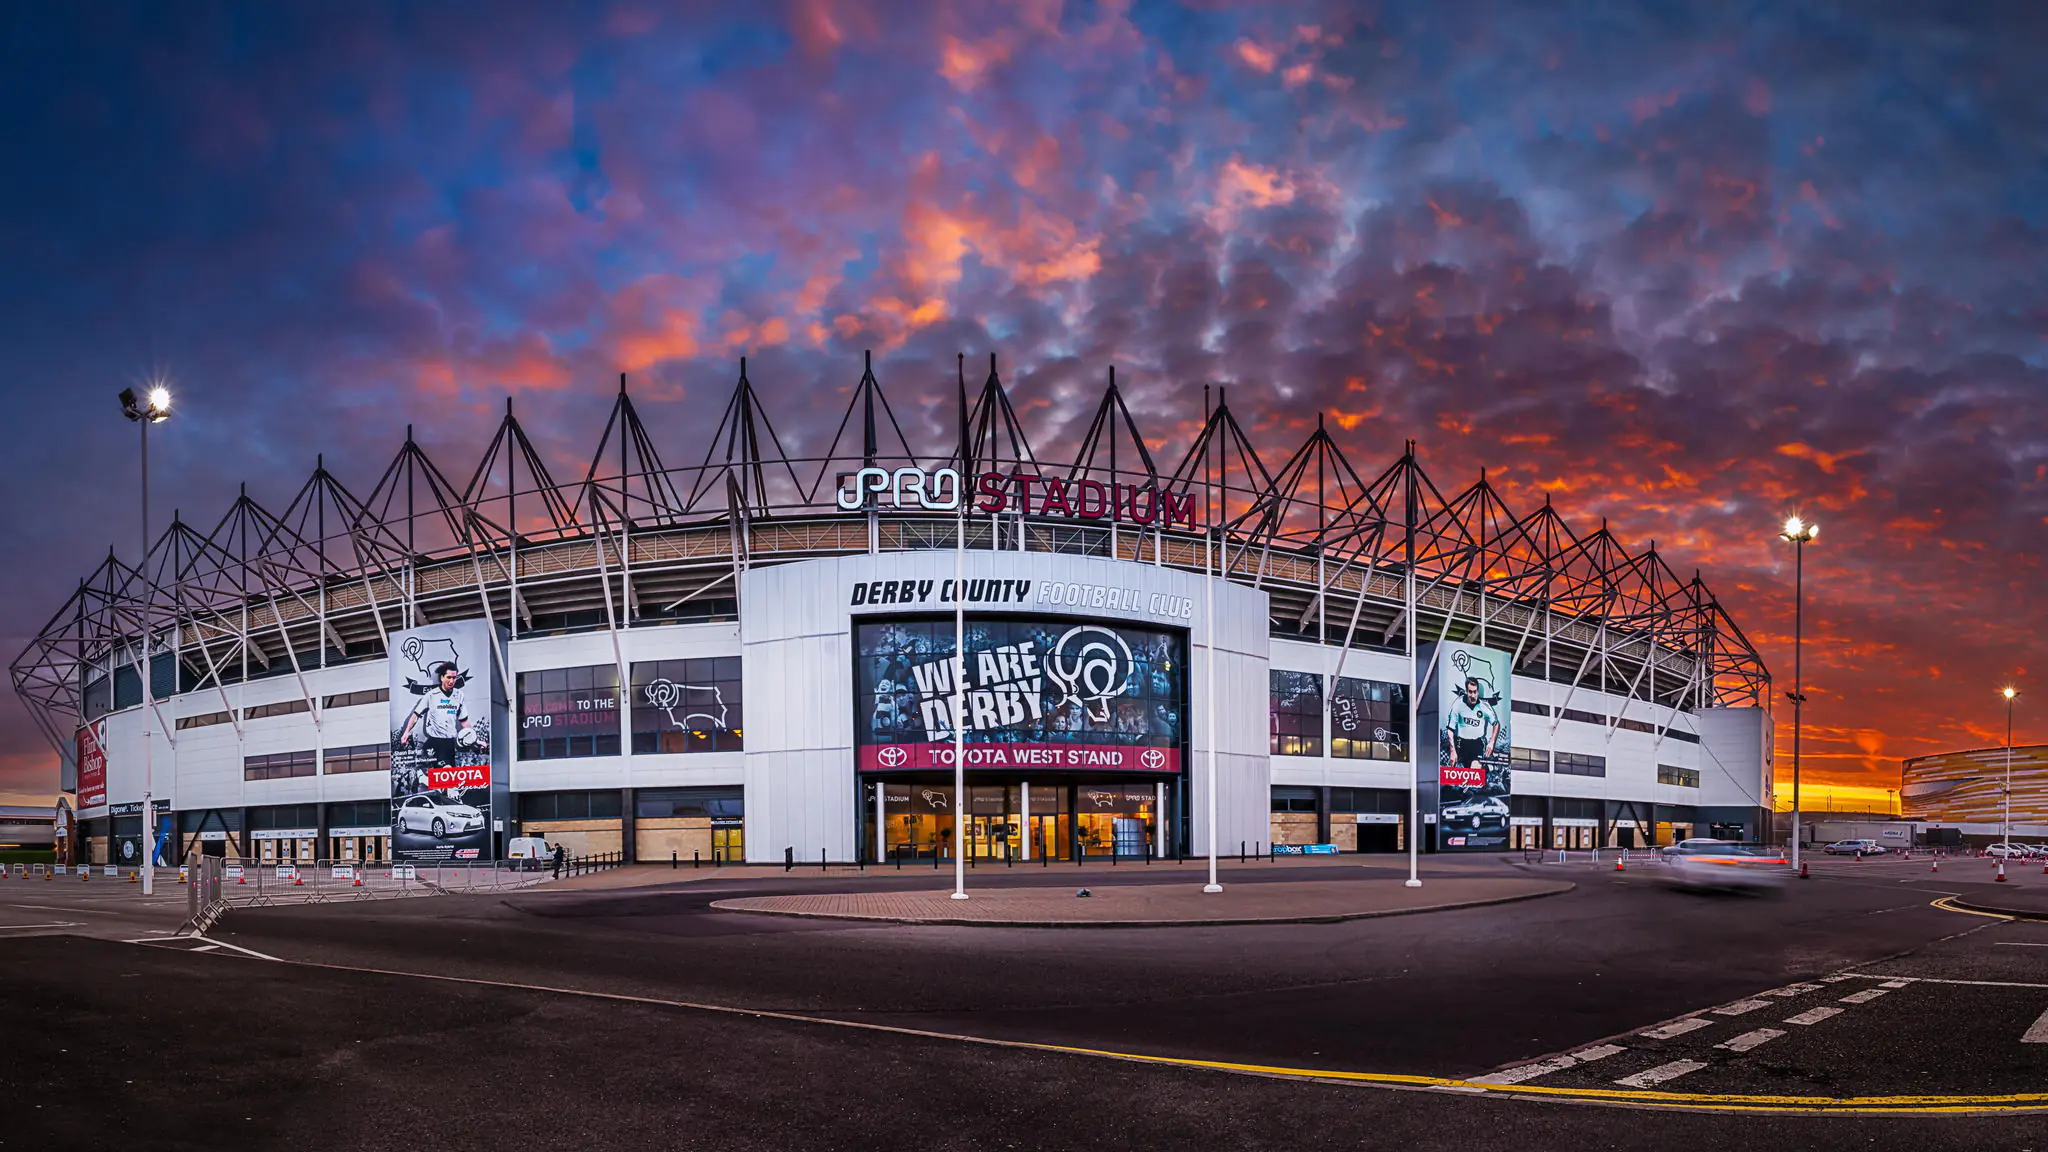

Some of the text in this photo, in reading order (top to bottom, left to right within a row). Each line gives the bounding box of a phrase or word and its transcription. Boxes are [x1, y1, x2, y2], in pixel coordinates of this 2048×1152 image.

[979, 472, 1197, 532] STADIUM
[851, 579, 1193, 619] DERBY COUNTY FOOTBALL CLUB
[911, 641, 1041, 699] WE ARE
[525, 698, 615, 715] WELCOME TO THE
[919, 677, 1042, 742] DERBY
[555, 710, 616, 727] STADIUM
[83, 736, 97, 756] Flint
[83, 753, 103, 776] Bishop
[928, 749, 1123, 766] TOYOTA WEST STAND
[433, 769, 483, 782] TOYOTA
[1443, 769, 1481, 781] TOYOTA
